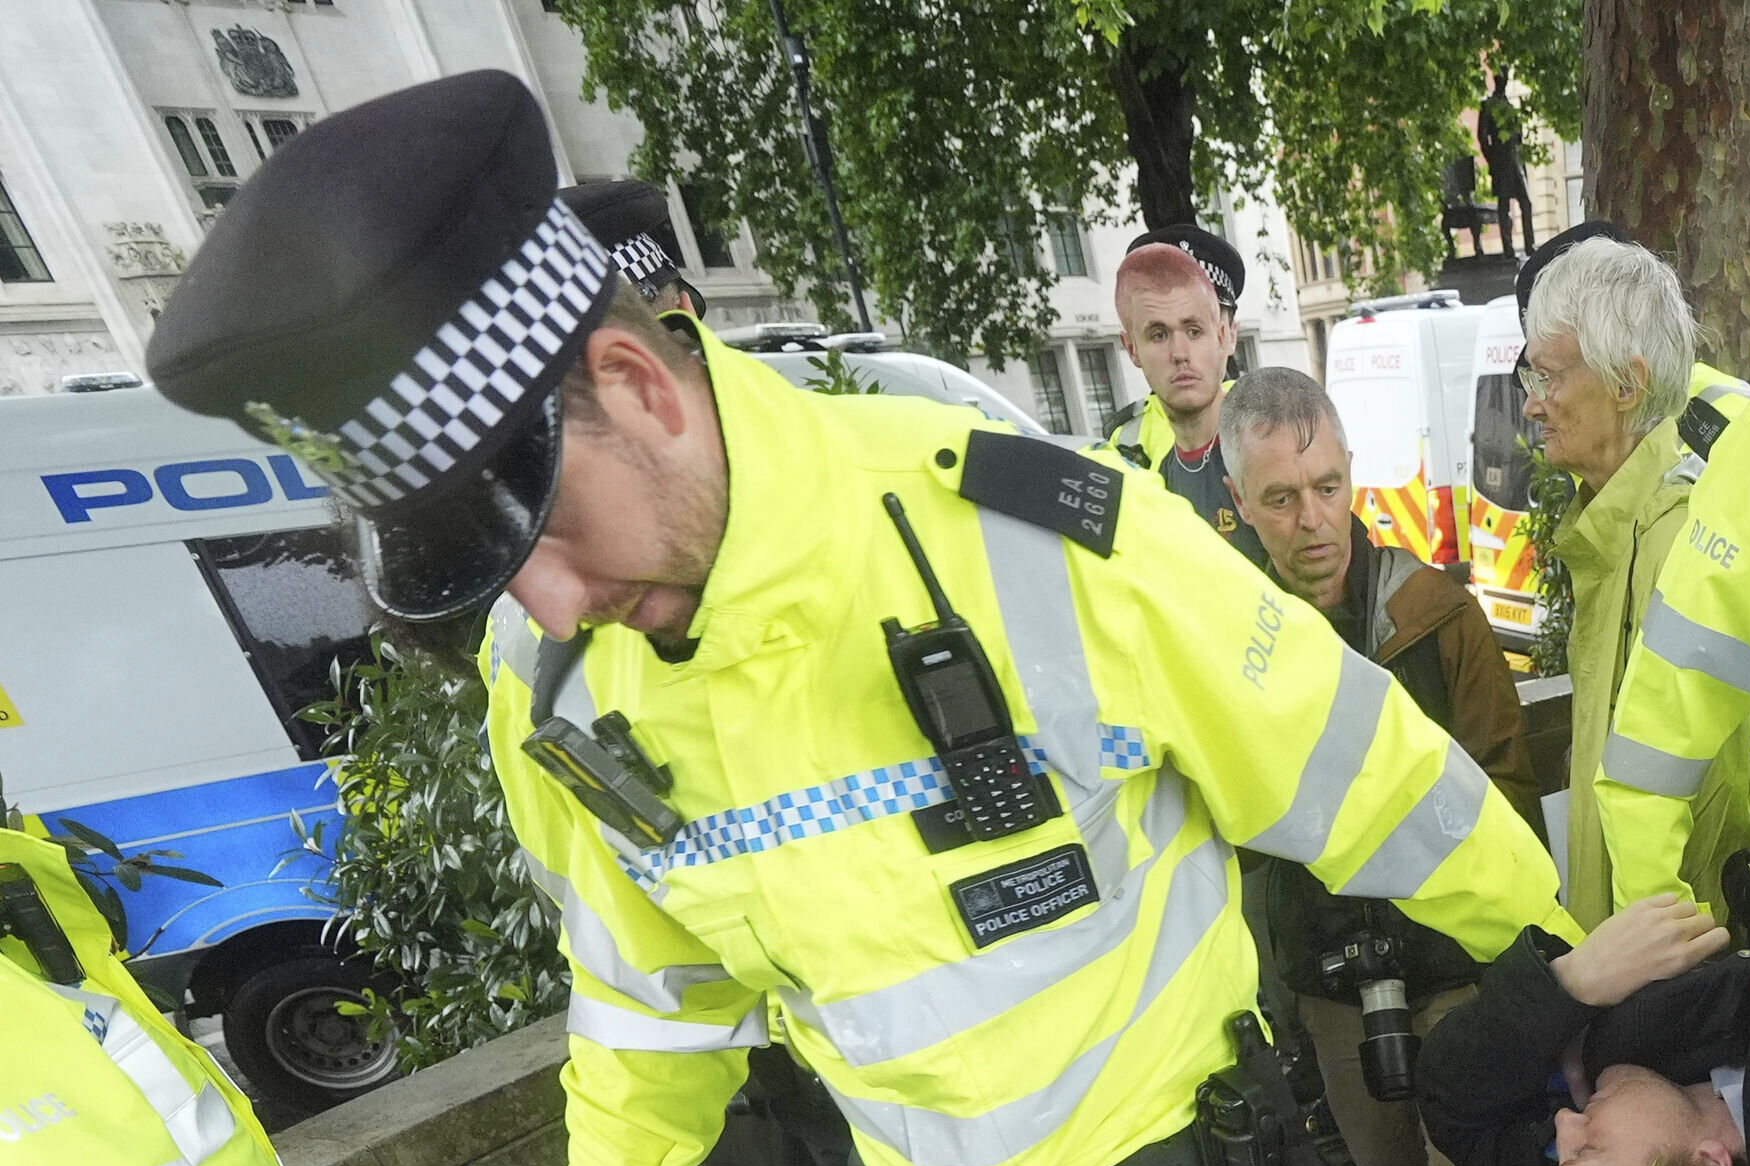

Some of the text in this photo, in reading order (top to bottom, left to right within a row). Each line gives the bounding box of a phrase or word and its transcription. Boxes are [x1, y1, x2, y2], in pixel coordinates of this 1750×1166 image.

[1371, 354, 1401, 369] POLICE
[1487, 345, 1519, 363] POLICE
[1058, 478, 1083, 508] EA
[1081, 472, 1110, 535] 2660
[1000, 858, 1071, 889] METROPOLITAN
[1014, 870, 1067, 899] POLICE
[974, 883, 1090, 936] POLICE OFFICER
